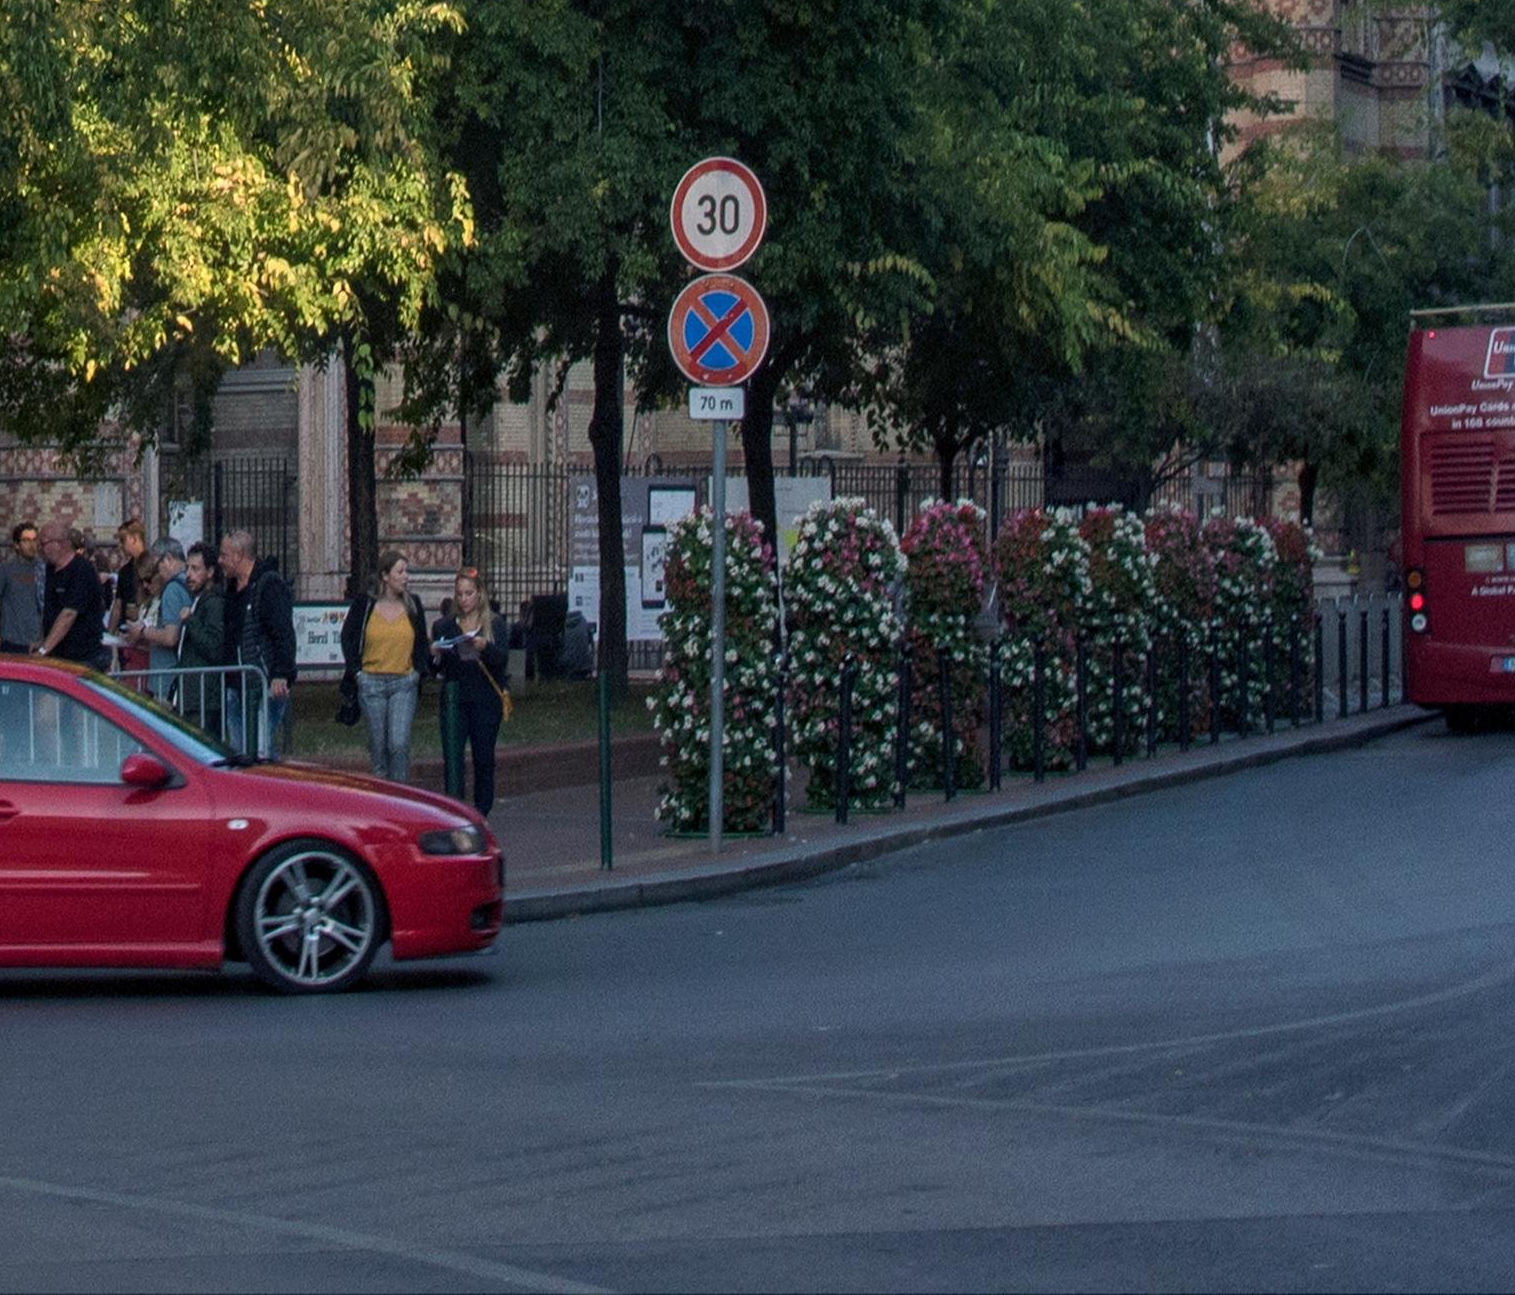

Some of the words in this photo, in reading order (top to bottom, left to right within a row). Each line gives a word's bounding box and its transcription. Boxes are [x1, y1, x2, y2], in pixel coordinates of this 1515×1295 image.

[696, 194, 740, 236] 30
[1471, 378, 1514, 392] UnionPay
[700, 396, 717, 411] 70
[720, 398, 733, 411] m
[1430, 404, 1477, 416] UnionPay
[1479, 401, 1509, 412] Cards
[1452, 419, 1462, 429] in
